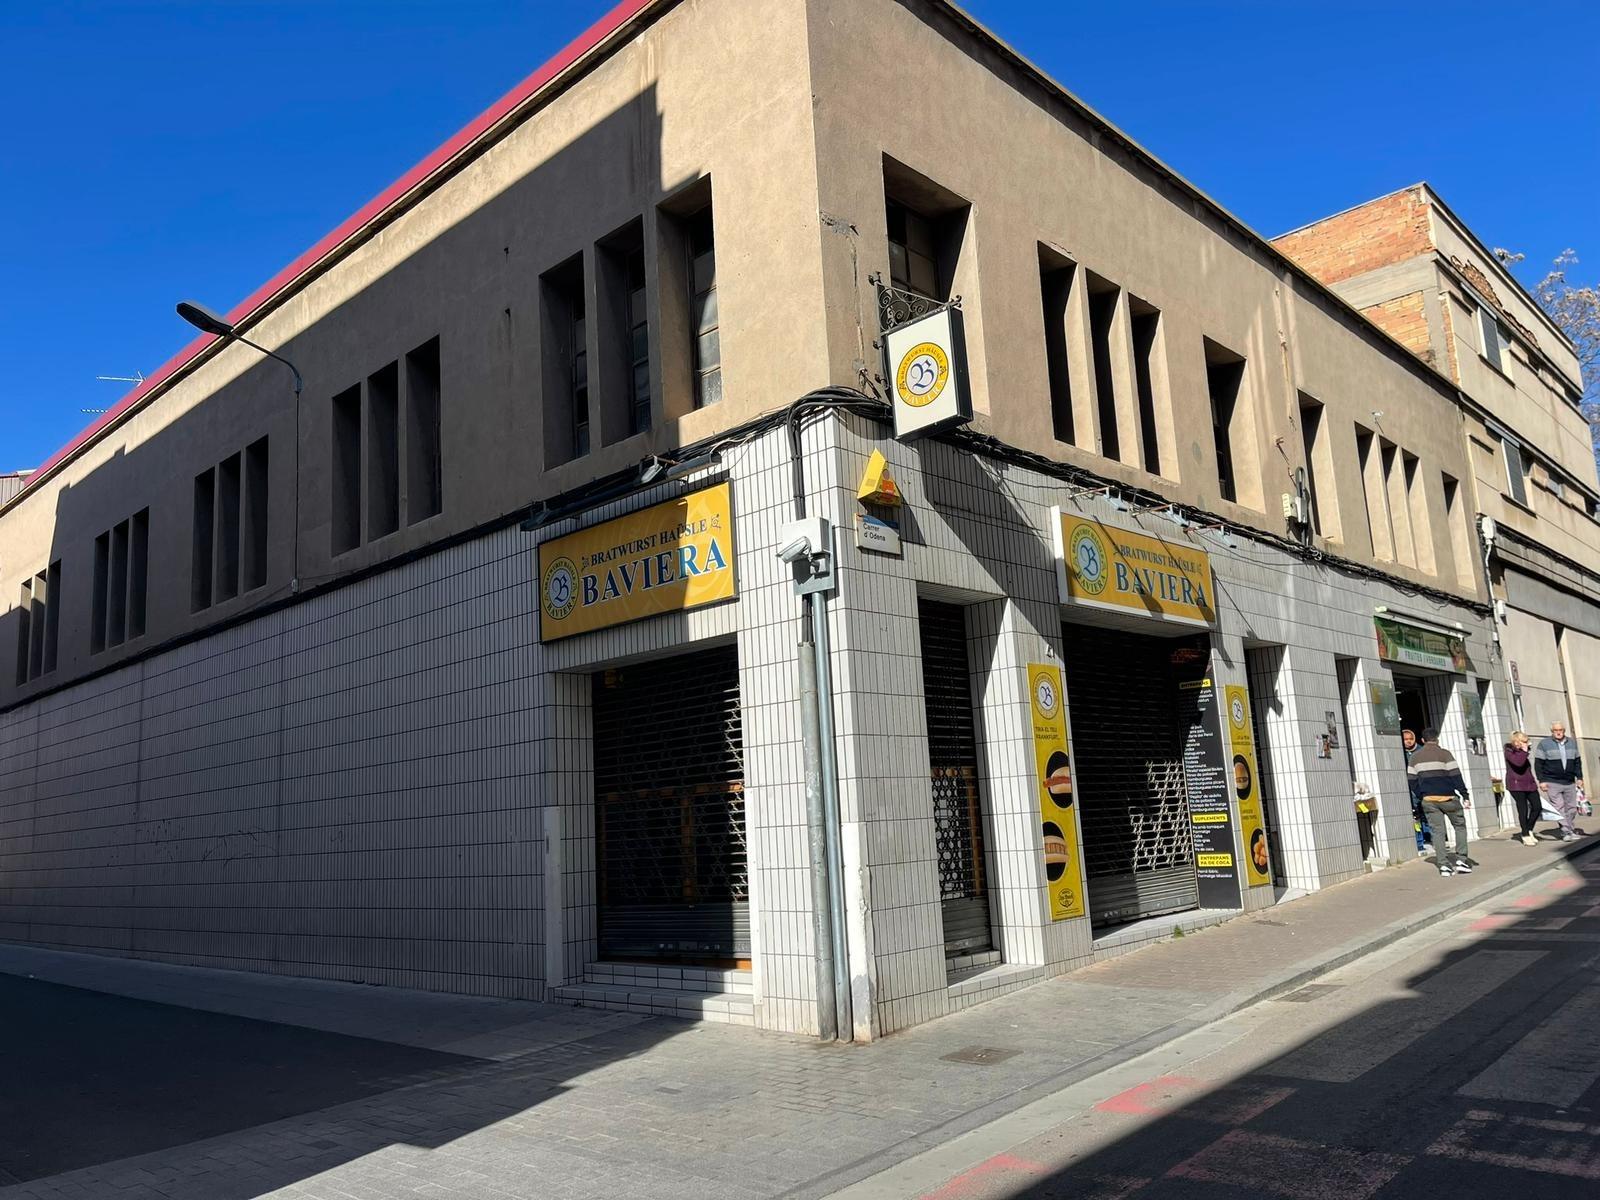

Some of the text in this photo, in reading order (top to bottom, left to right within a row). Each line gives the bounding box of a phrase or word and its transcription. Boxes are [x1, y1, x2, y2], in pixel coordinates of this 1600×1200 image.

[863, 522, 880, 532] Carrer
[590, 534, 657, 566] BRATWURST
[1119, 544, 1167, 566] BRATWURST
[582, 538, 728, 607] BAVIERA
[1114, 562, 1208, 608] BAVIERA
